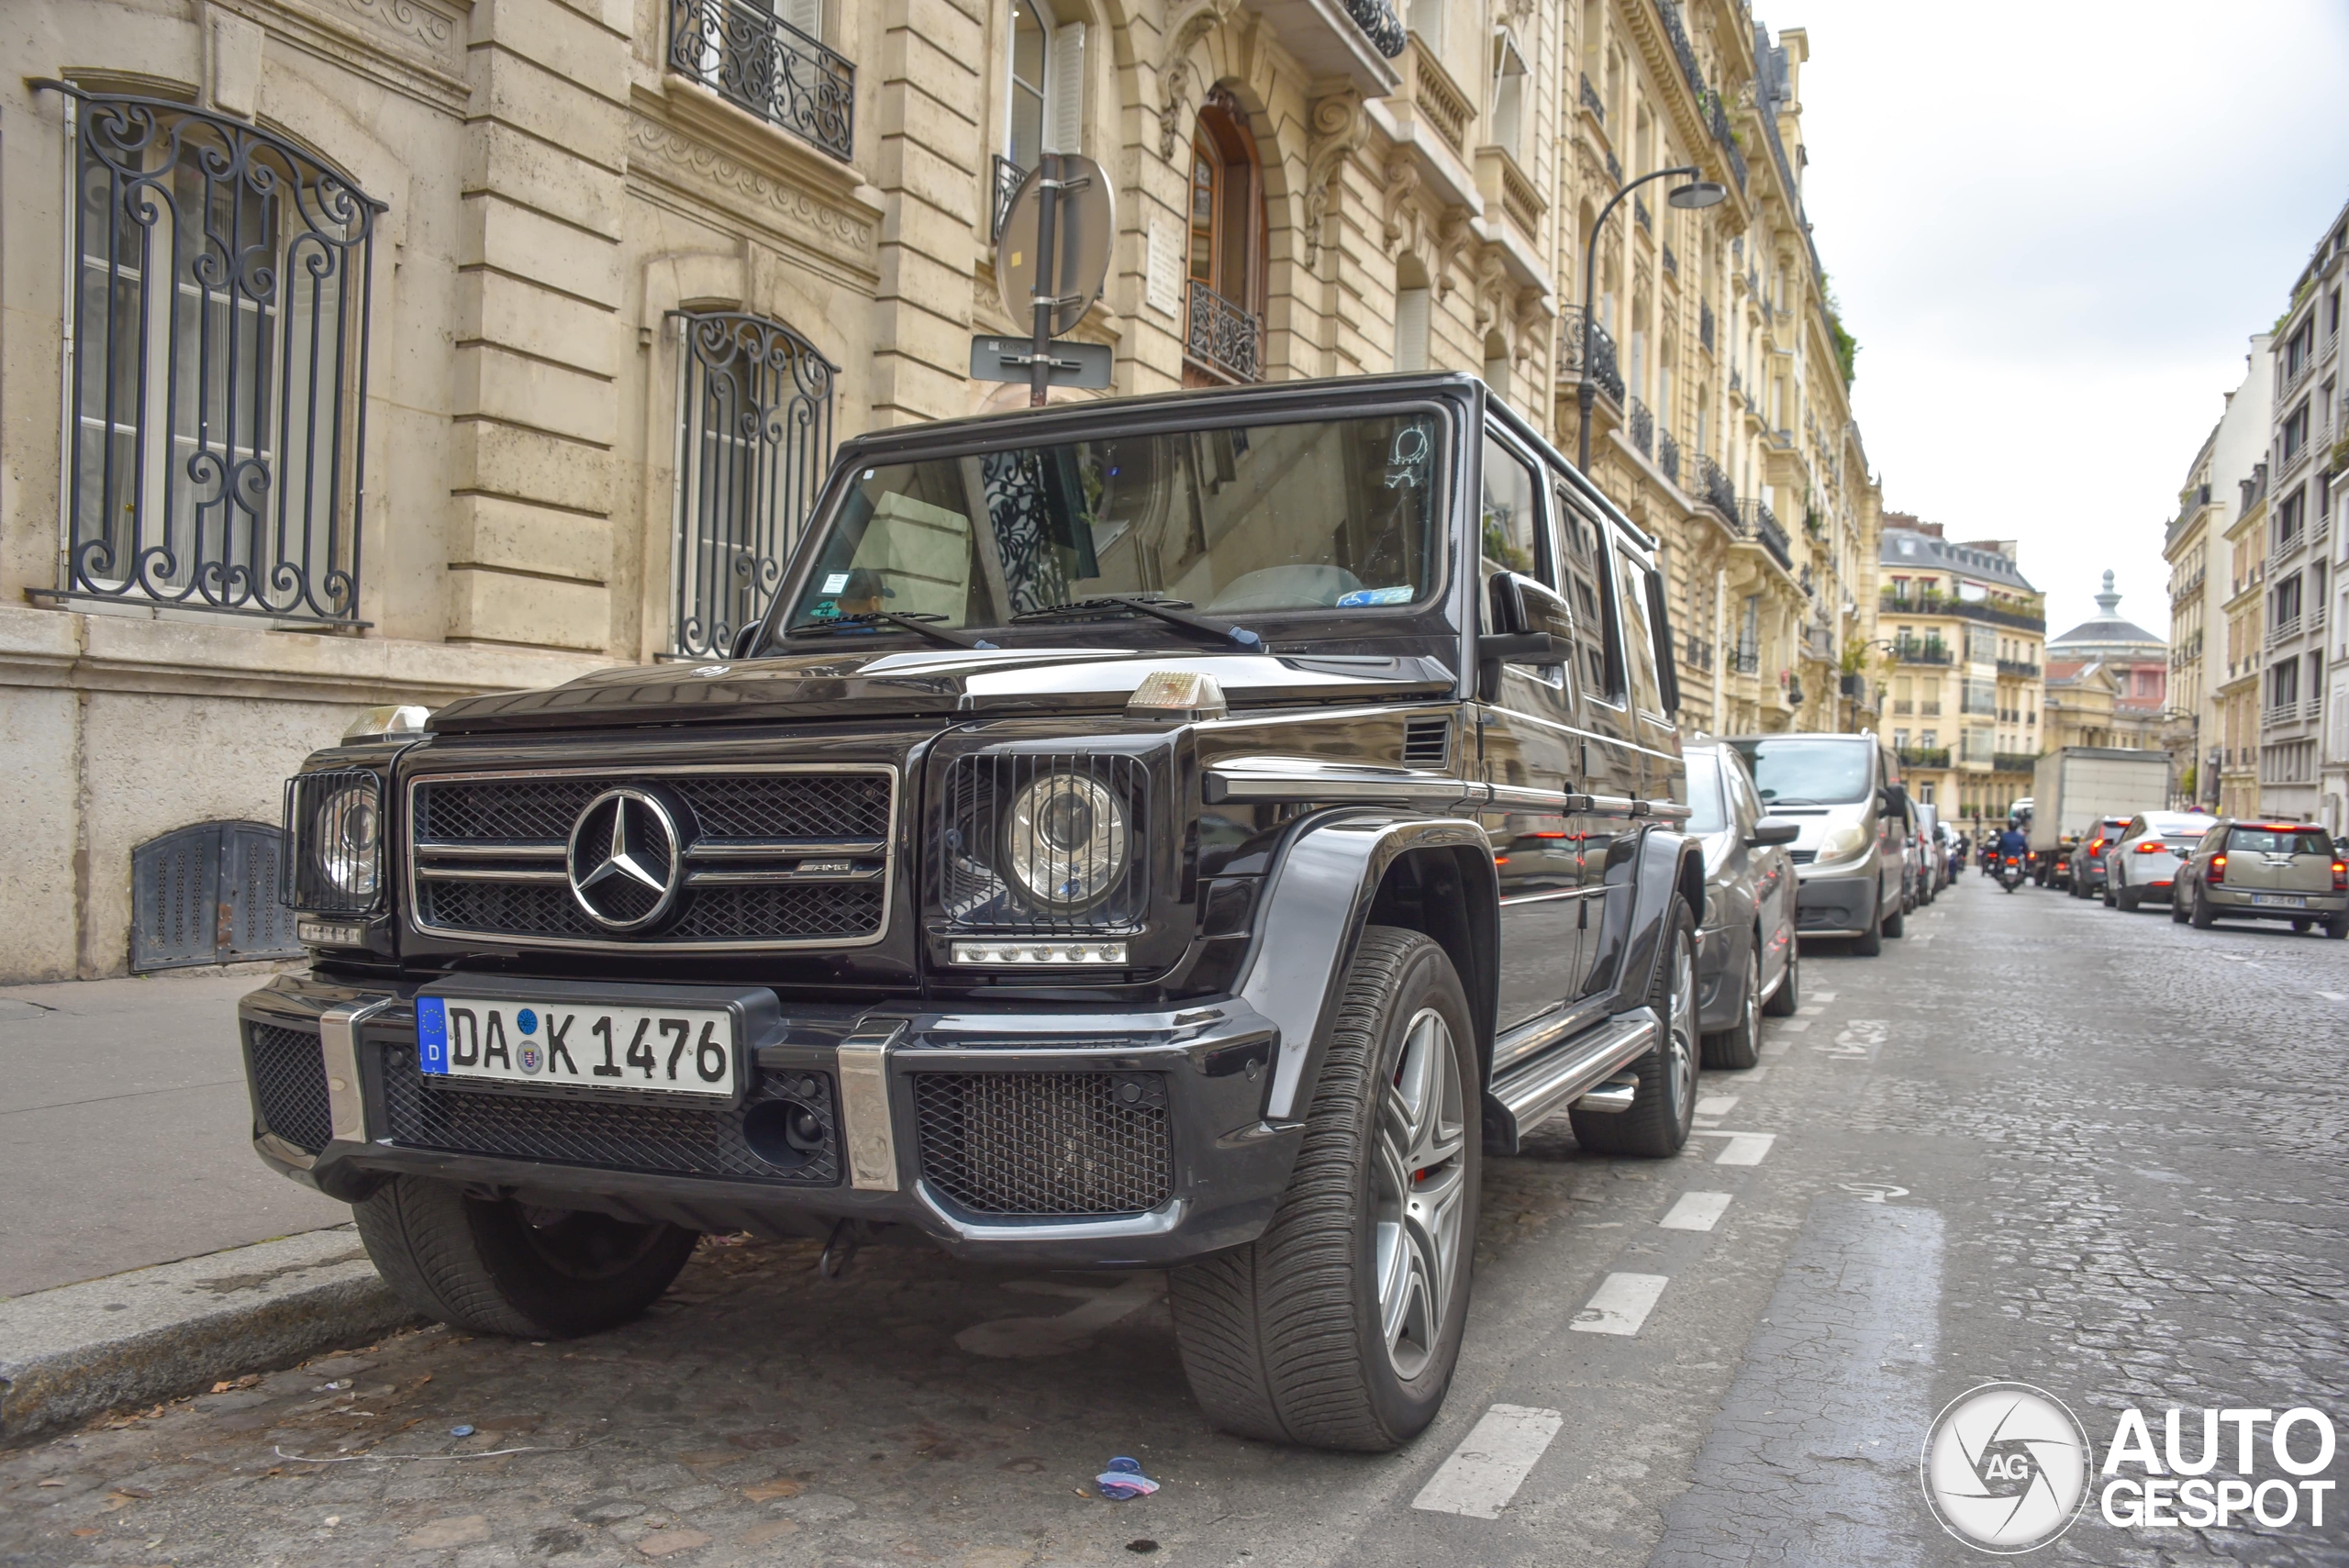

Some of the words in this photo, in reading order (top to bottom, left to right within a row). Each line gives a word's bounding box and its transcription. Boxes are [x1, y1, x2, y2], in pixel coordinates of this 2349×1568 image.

[429, 1044, 440, 1062] D
[450, 1007, 510, 1069] DA
[546, 1012, 579, 1074] K
[593, 1016, 726, 1082] 1476
